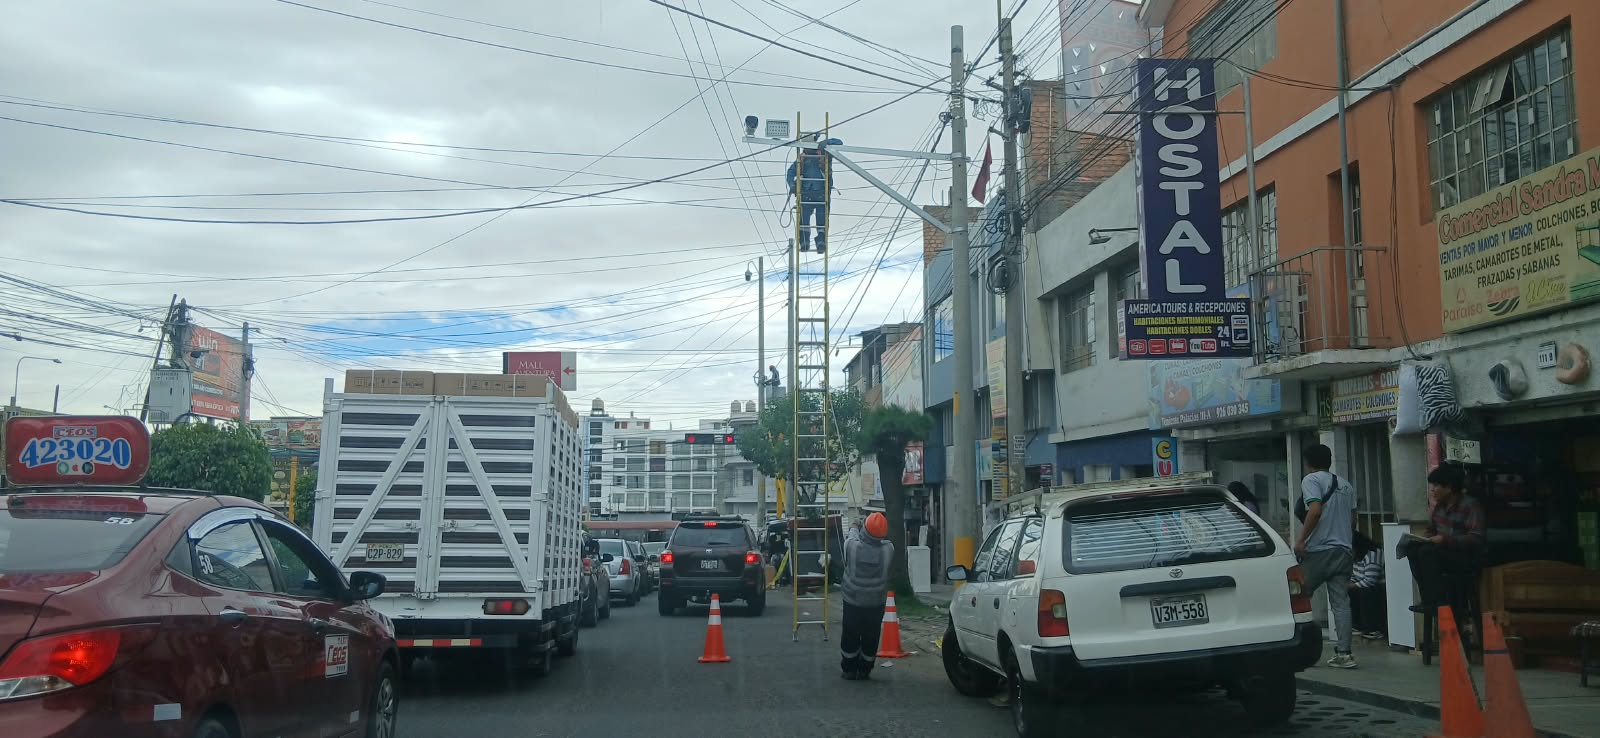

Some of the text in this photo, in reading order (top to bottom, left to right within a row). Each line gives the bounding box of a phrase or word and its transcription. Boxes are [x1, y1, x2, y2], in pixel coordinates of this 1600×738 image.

[1152, 67, 1211, 294] HOSTAL
[1439, 185, 1519, 245] Comercial
[1520, 166, 1587, 216] Sandra
[1439, 246, 1462, 265] VENTAS
[1463, 243, 1476, 257] POR
[1477, 237, 1499, 254] MAYOR
[1501, 233, 1506, 245] Y
[1508, 222, 1533, 242] MENOR
[1536, 203, 1589, 232] COLCHONES,
[1444, 234, 1563, 281] TARIMAS, CAMAROTES DE METAL,
[1477, 267, 1515, 289] FRAZADAS
[1522, 254, 1561, 276] SABANAS
[1128, 302, 1246, 314] AMERICA TOURS & RECEPCIONES
[1133, 316, 1177, 325] HABITACIONES
[1146, 326, 1189, 335] HABITACIONES
[1217, 326, 1230, 338] 24
[517, 360, 544, 369] MALL
[1238, 402, 1249, 415] 345
[56, 428, 94, 437] CEOS
[20, 438, 131, 468] 423020
[104, 516, 135, 525] 58
[367, 548, 402, 559] C2P-829
[199, 554, 214, 575] 58
[1154, 602, 1205, 623] V3M-558
